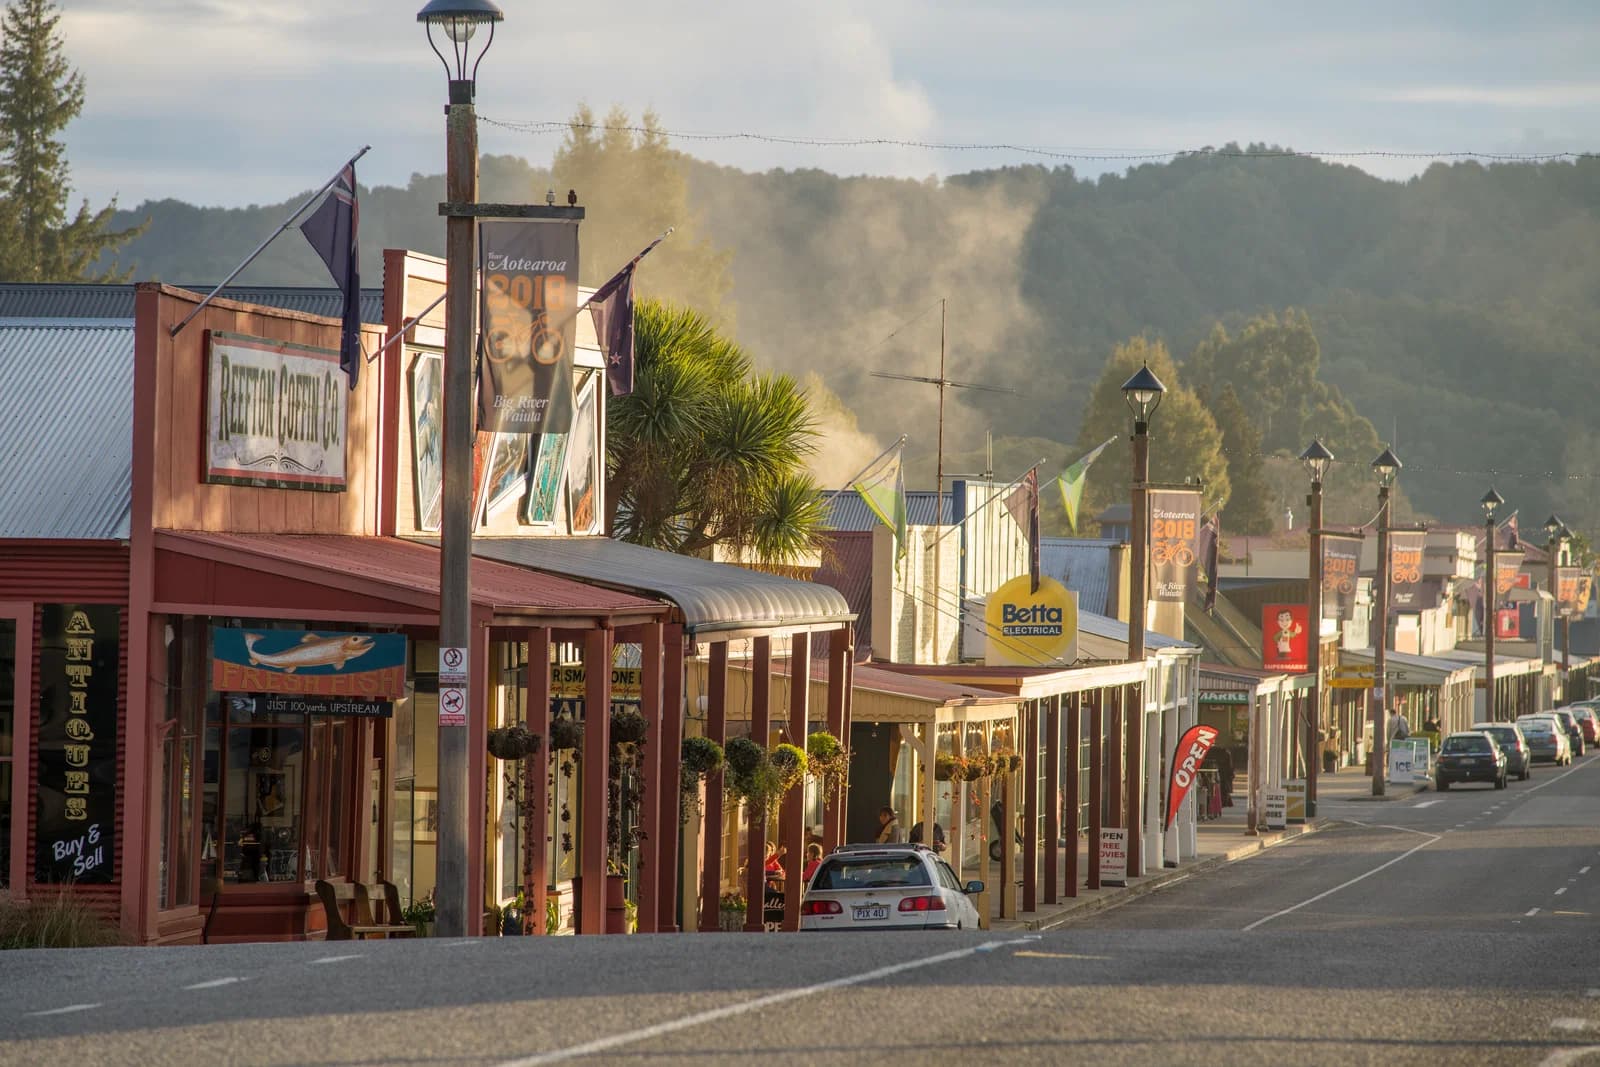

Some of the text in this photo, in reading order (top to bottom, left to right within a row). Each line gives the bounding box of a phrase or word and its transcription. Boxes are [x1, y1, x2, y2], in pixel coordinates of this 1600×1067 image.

[487, 255, 567, 271] Aotearoa
[218, 353, 276, 441] REEFTON
[278, 364, 320, 446] COFFIN
[493, 394, 549, 410] Big River
[1153, 519, 1196, 539] 2018
[1002, 603, 1063, 623] Betta
[1003, 626, 1061, 635] ELECTRICAL
[221, 660, 399, 694] FRESH FISH
[266, 697, 287, 711] JUST
[330, 701, 380, 714] UPSTREAM
[64, 610, 95, 820] ANTIQUES
[1175, 729, 1217, 788] OPEN
[1395, 761, 1411, 771] ICE
[52, 823, 101, 861] Buy &
[1101, 832, 1124, 840] PEN
[1100, 850, 1126, 859] OVIES
[1102, 842, 1121, 850] REE
[73, 846, 103, 876] Sell
[856, 909, 871, 918] PIX
